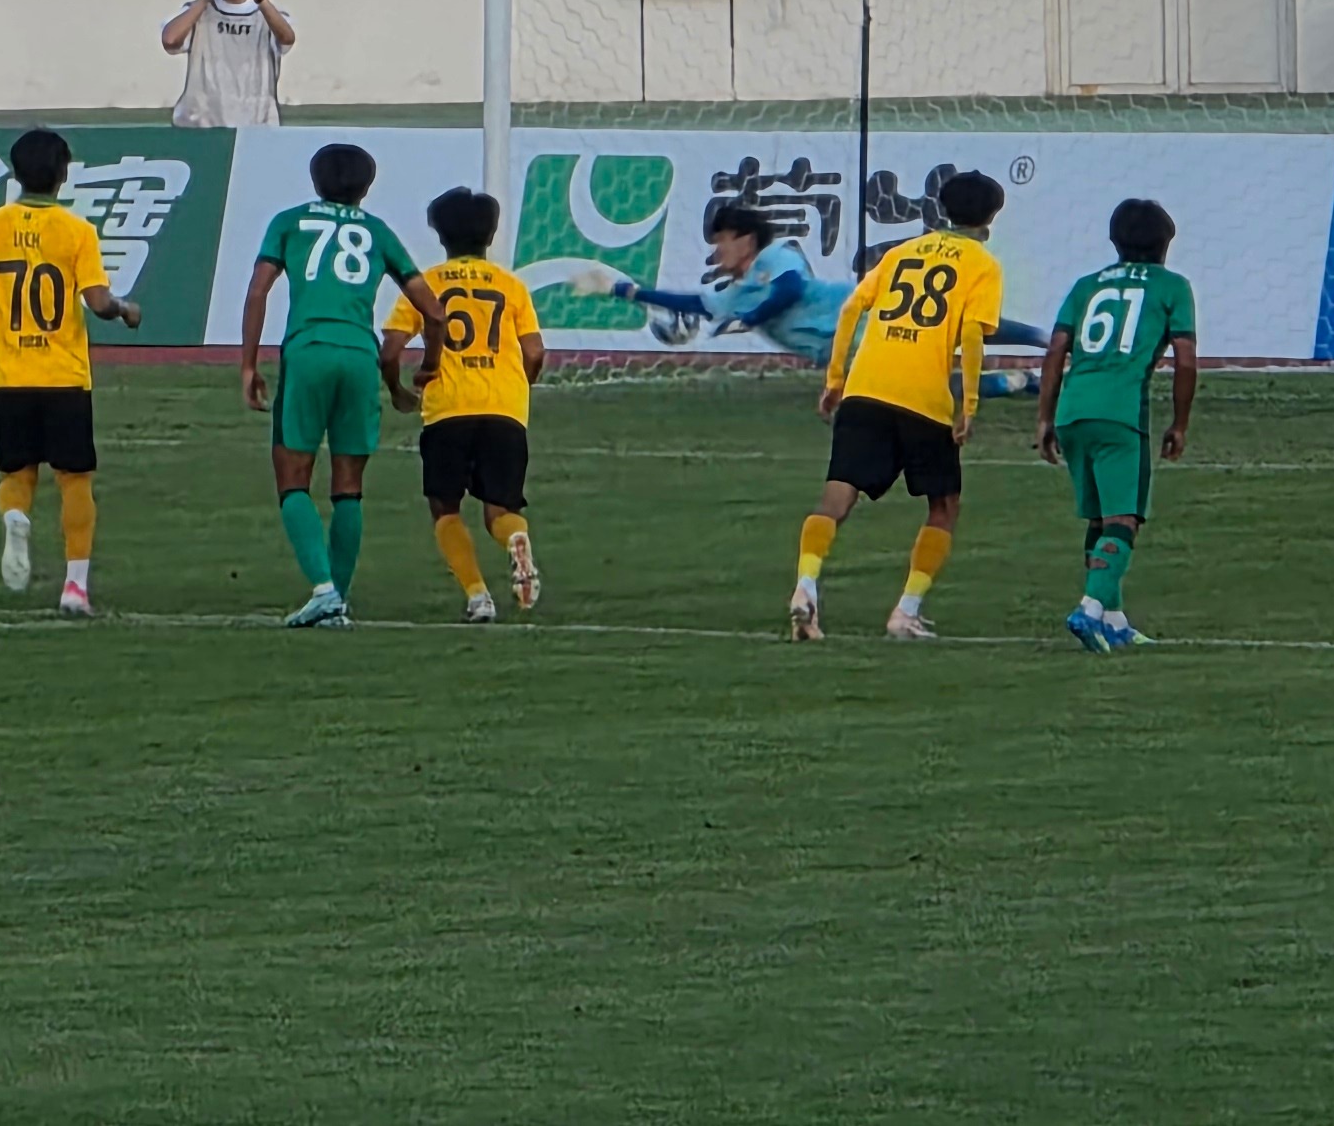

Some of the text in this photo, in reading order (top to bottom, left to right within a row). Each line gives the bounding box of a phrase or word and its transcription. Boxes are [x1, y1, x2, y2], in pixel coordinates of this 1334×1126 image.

[299, 219, 372, 284] 78
[439, 287, 505, 354] 67
[879, 258, 957, 327] 58
[1080, 288, 1145, 354] 61
